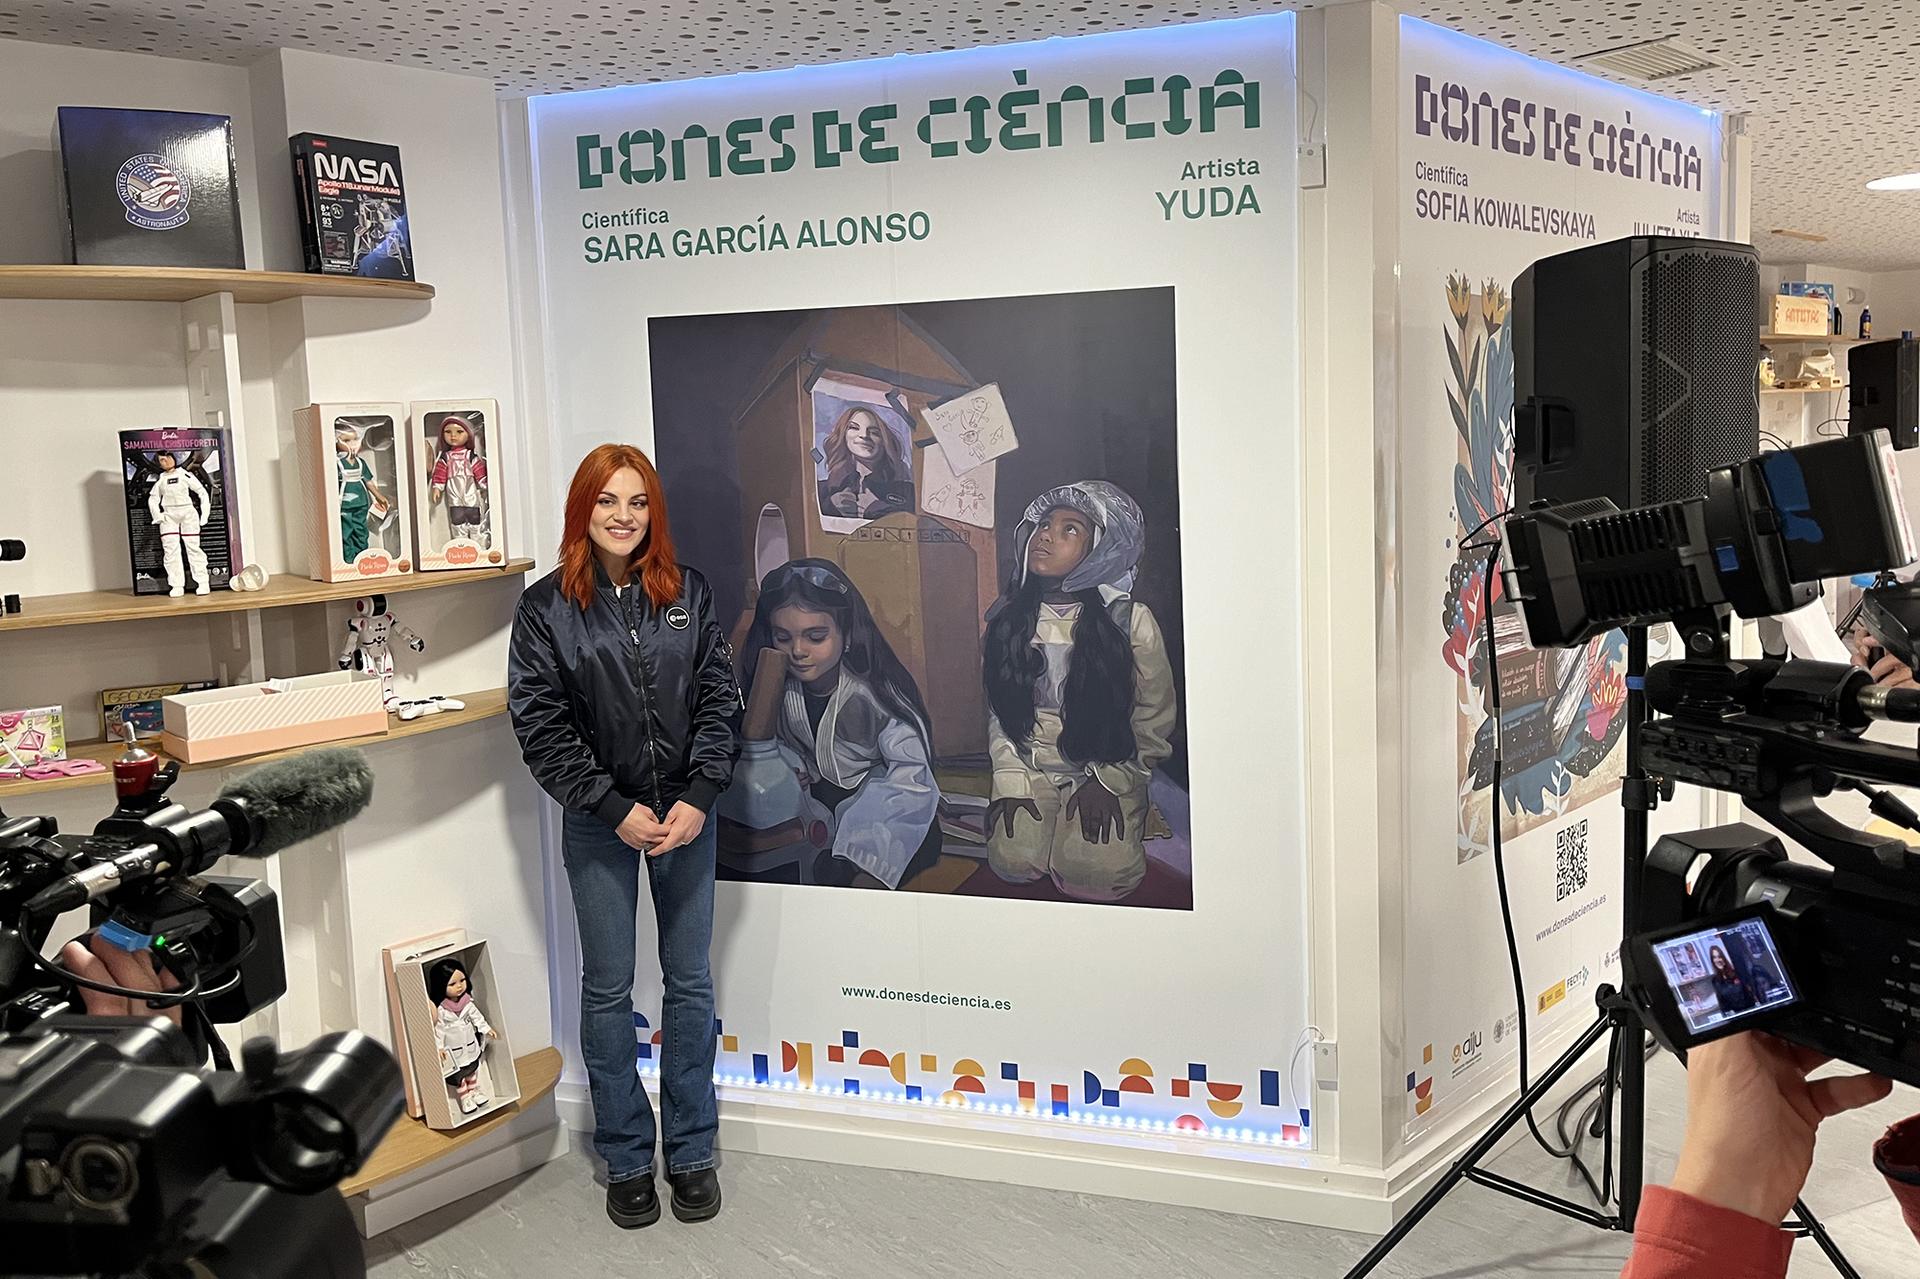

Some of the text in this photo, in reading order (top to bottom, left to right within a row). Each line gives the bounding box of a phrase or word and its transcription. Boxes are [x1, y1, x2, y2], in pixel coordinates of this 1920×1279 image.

[811, 103, 900, 169] DE
[118, 172, 131, 202] UNITED
[125, 156, 154, 171] STATES
[313, 152, 400, 188] NASA
[1180, 157, 1261, 181] Artista
[1415, 160, 1469, 187] Científica
[1155, 184, 1262, 221] YUDA
[1416, 188, 1470, 224] SOFIA
[1474, 197, 1597, 240] KOWALEVSKAYA
[1676, 207, 1700, 225] Artista
[136, 217, 180, 228] ASTRONAUT
[581, 207, 670, 230] Científica
[583, 211, 931, 264] SARA GARCÍA ALONSO
[123, 438, 219, 450] SAMANTHA CRISTOFORETTI
[1535, 894, 1607, 942] www.donesdeciencia.es
[841, 986, 1012, 1011] www.donesdeciencia.es
